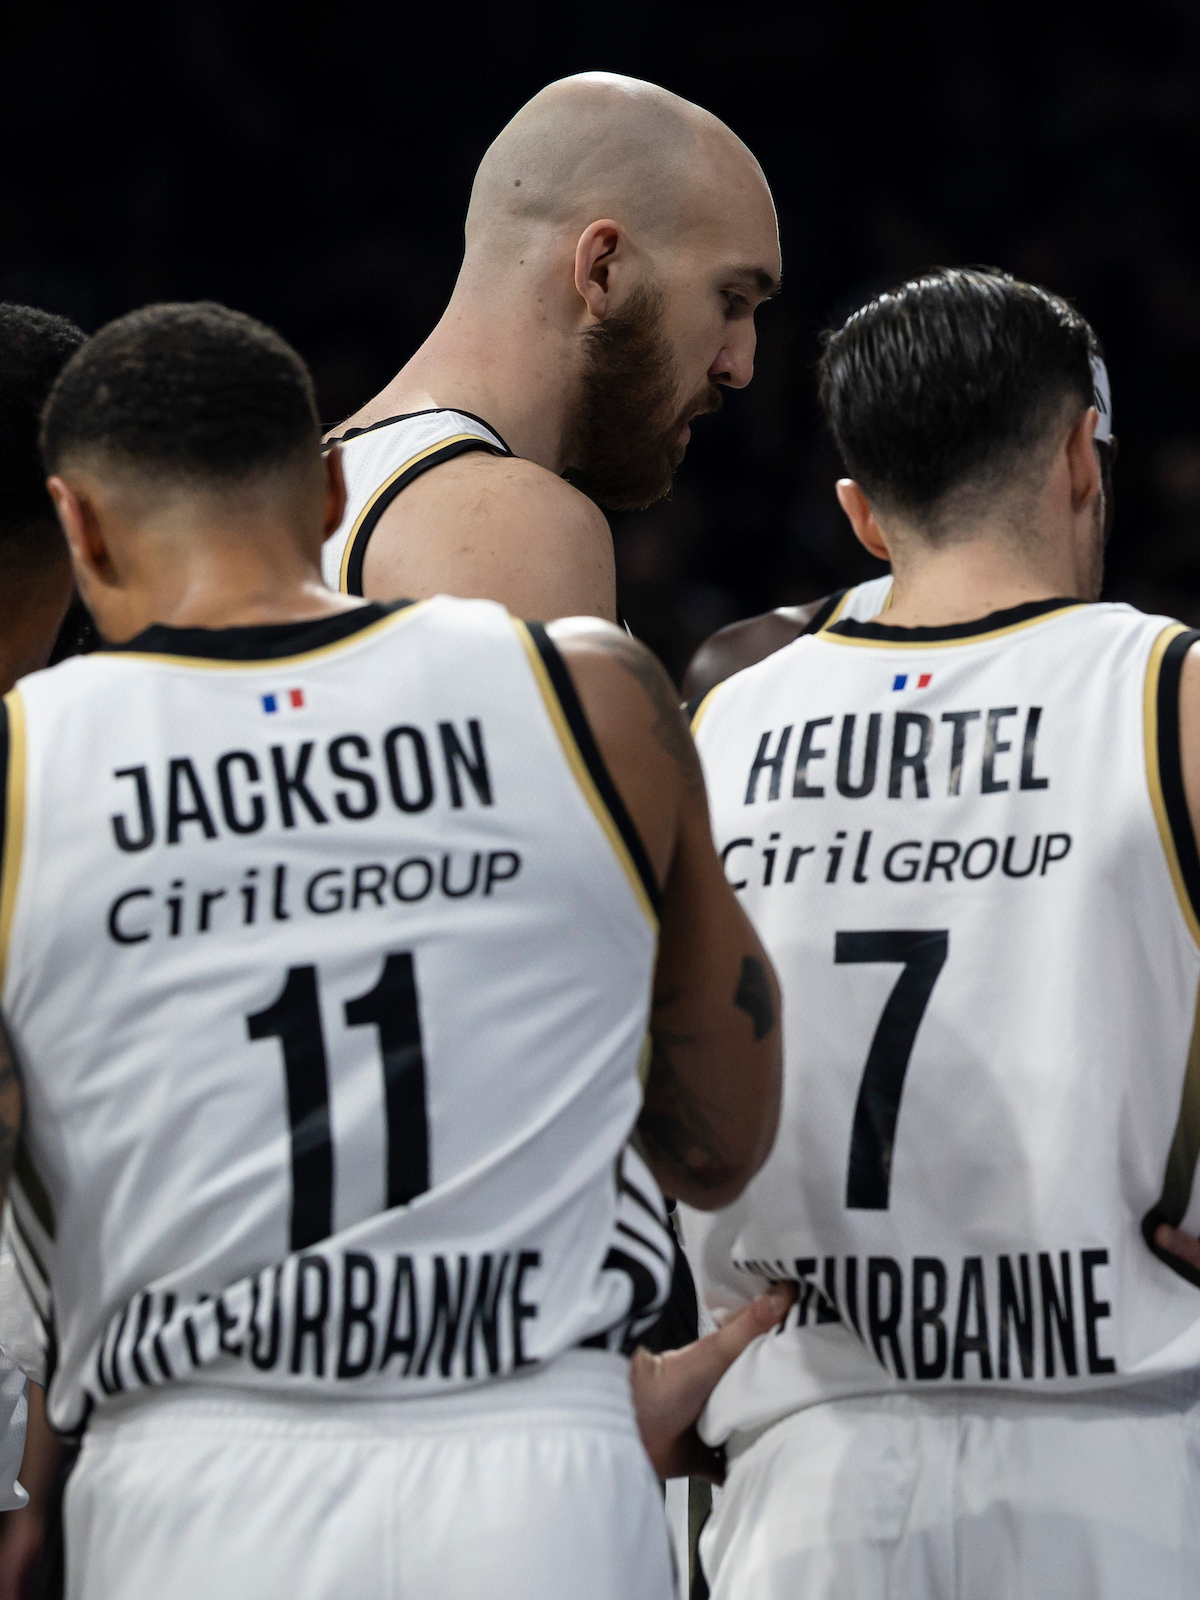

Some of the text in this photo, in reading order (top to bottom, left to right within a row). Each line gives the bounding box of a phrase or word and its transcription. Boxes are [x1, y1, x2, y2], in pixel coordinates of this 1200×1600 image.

[111, 718, 495, 854] JACKSON
[744, 706, 1050, 805] HEURTEL
[246, 950, 431, 1252] 11
[834, 929, 949, 1211] 7
